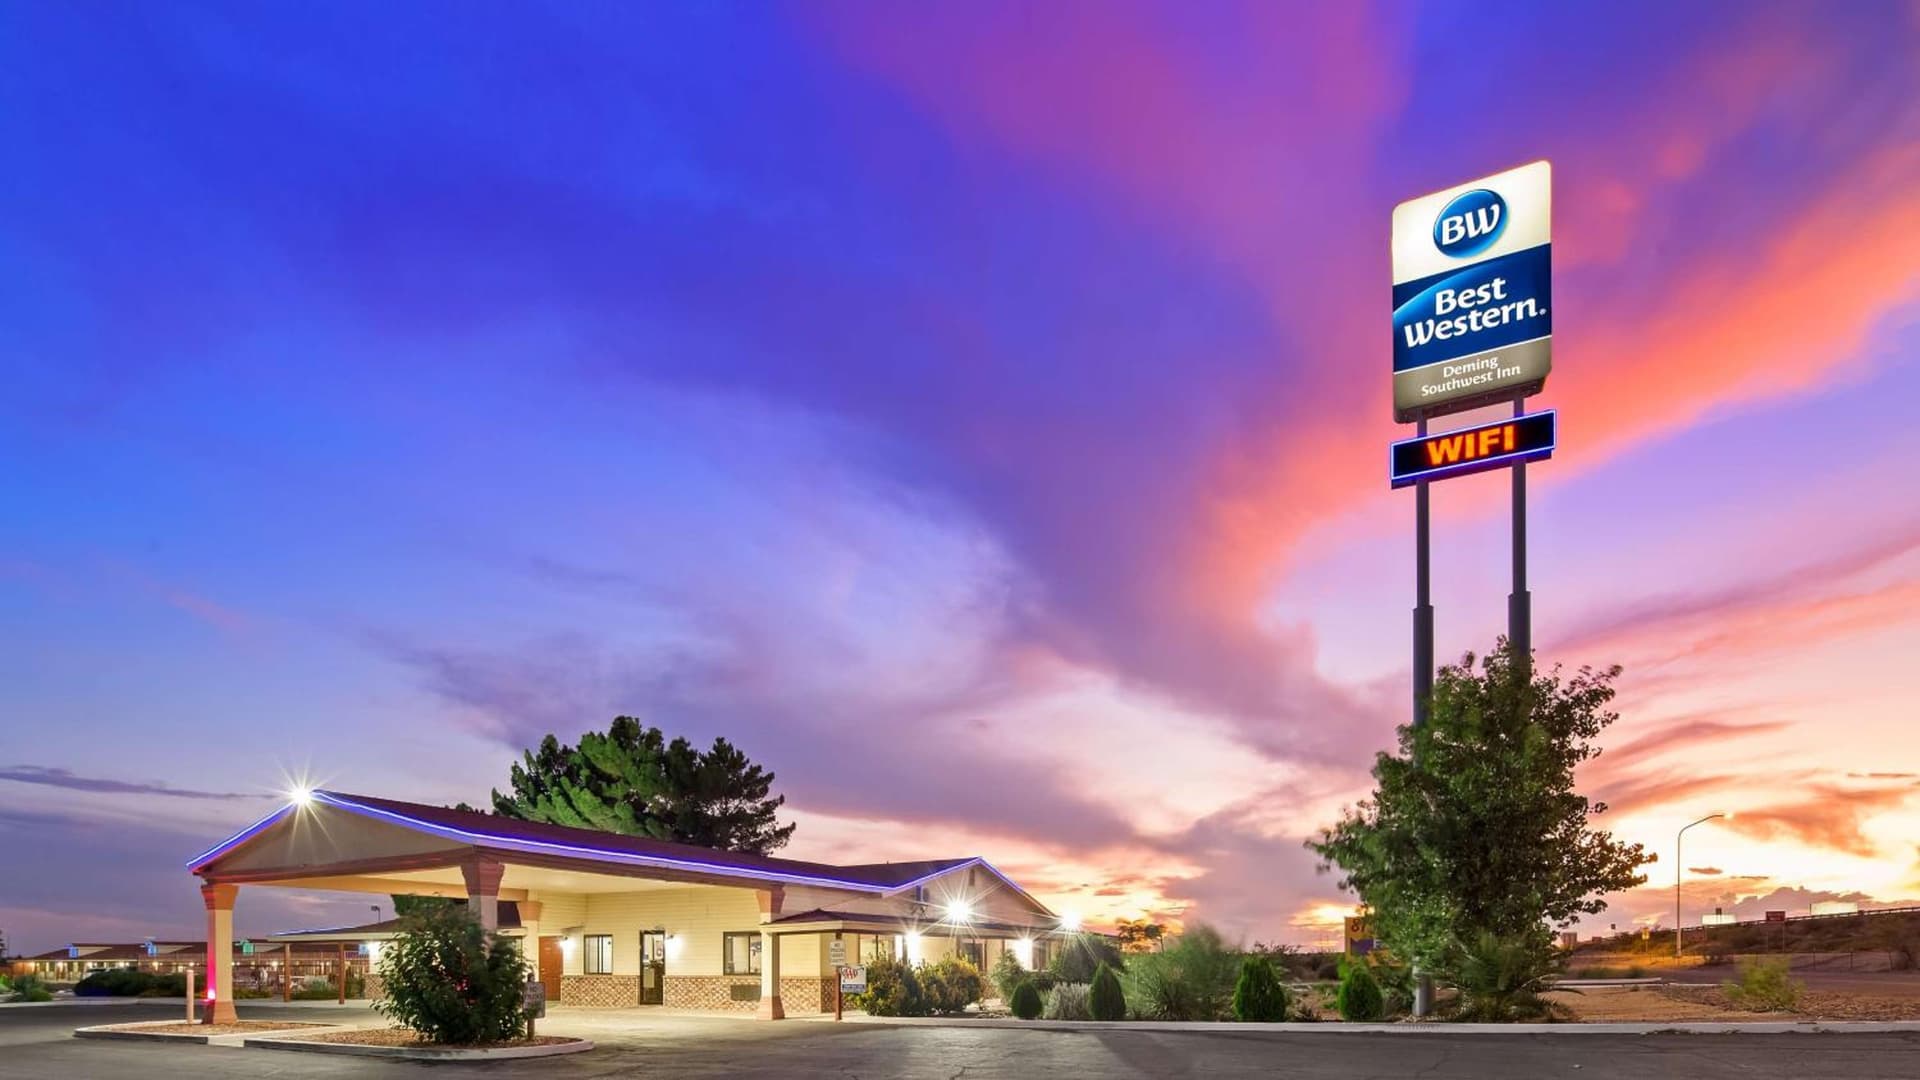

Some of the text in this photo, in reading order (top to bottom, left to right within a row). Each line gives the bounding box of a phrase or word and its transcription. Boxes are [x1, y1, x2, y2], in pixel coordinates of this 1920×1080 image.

[1441, 203, 1500, 246] BW
[1435, 277, 1508, 316] Best
[1421, 365, 1521, 397] Southwest Inn
[1443, 356, 1499, 379] Deming
[1426, 425, 1516, 466] WIFI
